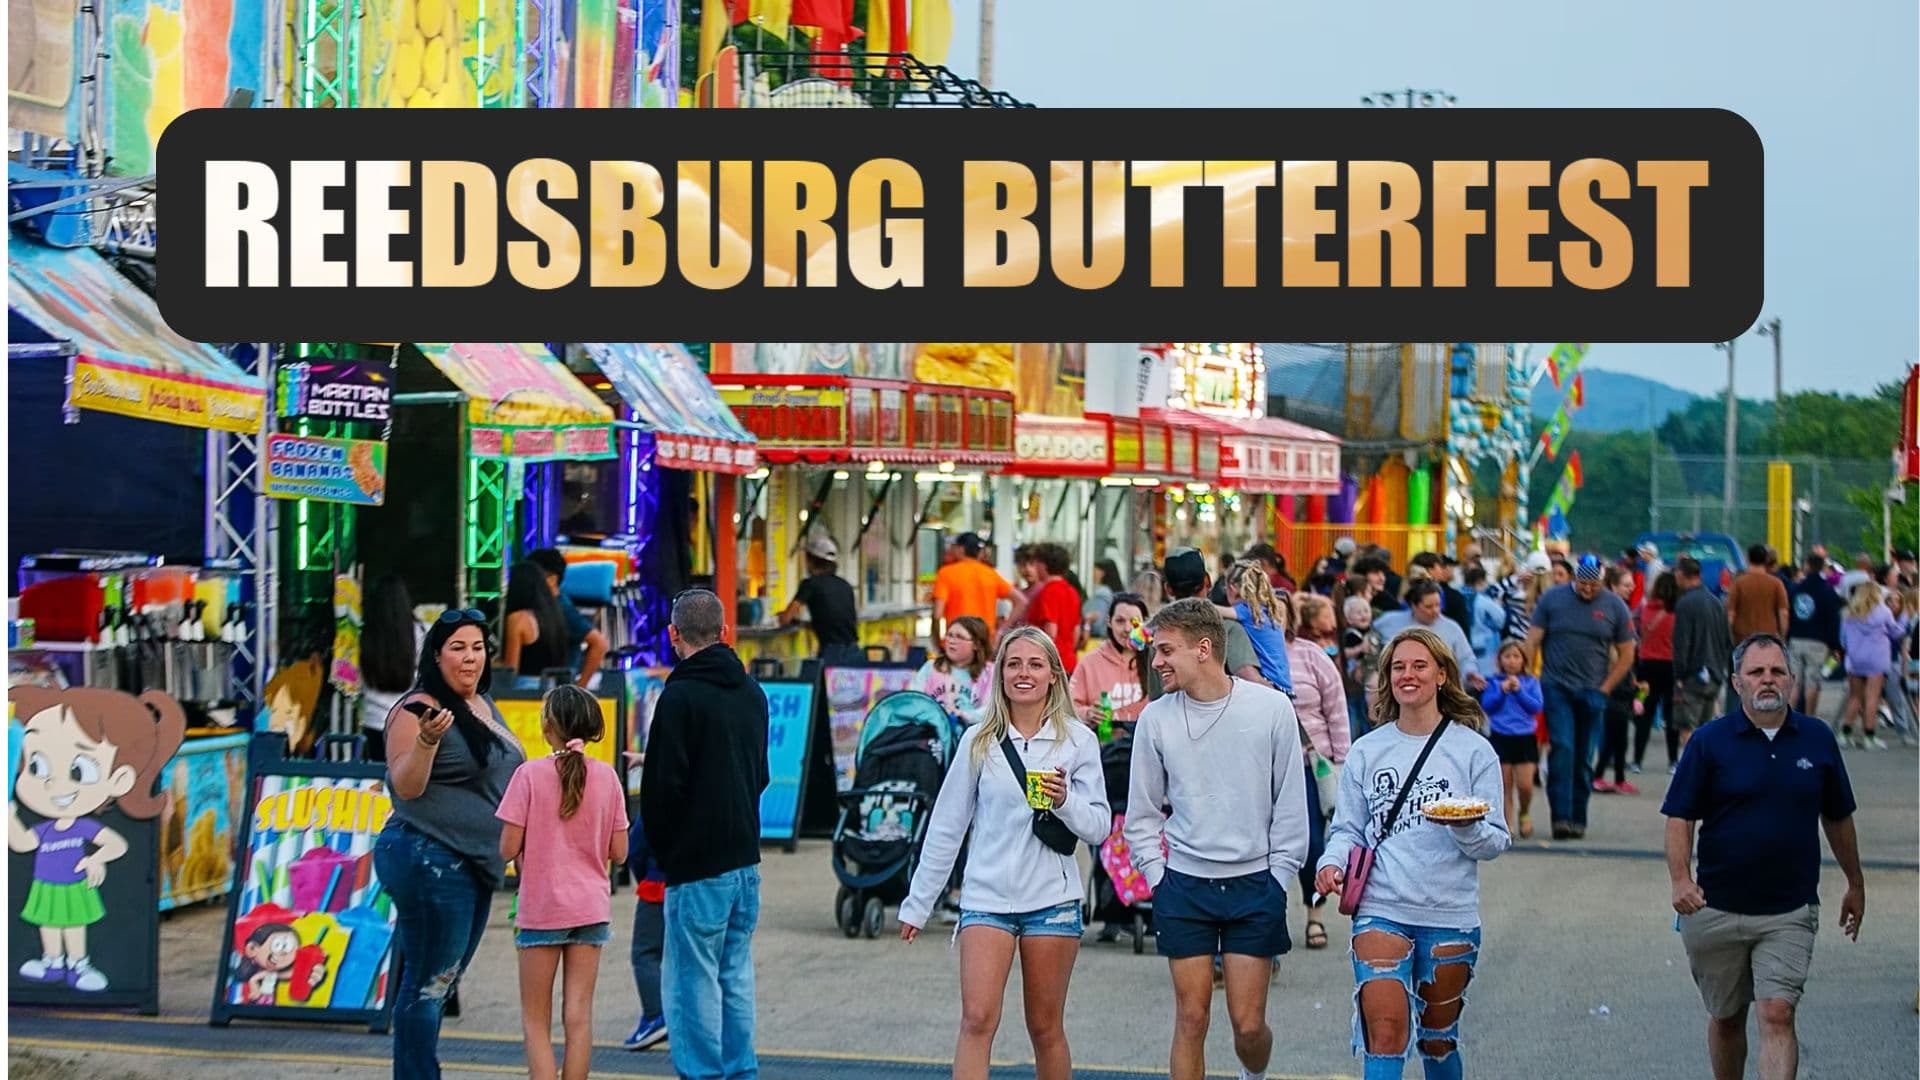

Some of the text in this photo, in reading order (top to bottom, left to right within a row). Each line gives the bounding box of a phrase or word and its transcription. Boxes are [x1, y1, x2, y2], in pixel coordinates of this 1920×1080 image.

[311, 383, 390, 401] MARTIAN
[308, 399, 390, 419] BOTTLES
[270, 440, 346, 461] FROZEN
[269, 459, 355, 480] BANANAS
